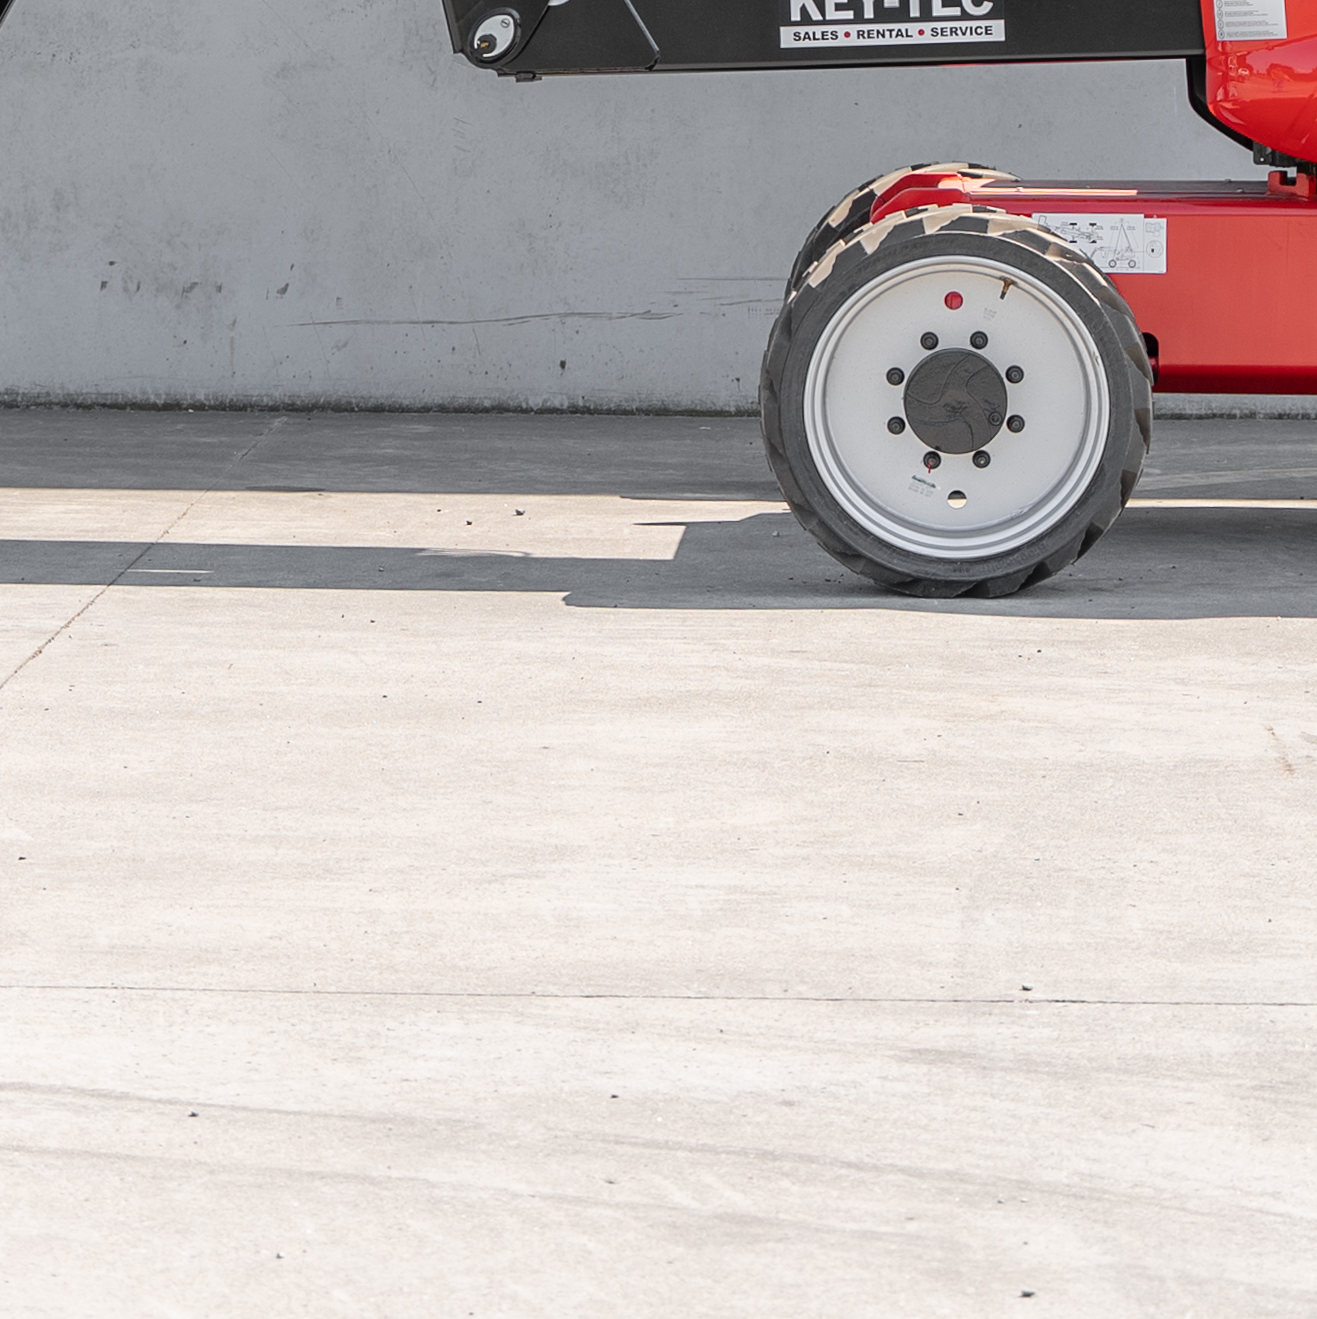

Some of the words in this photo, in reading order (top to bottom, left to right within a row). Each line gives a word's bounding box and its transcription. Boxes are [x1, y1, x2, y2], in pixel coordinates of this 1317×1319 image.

[792, 30, 839, 42] SALES
[856, 28, 914, 40] RENTAL
[930, 25, 994, 38] SERVICE
